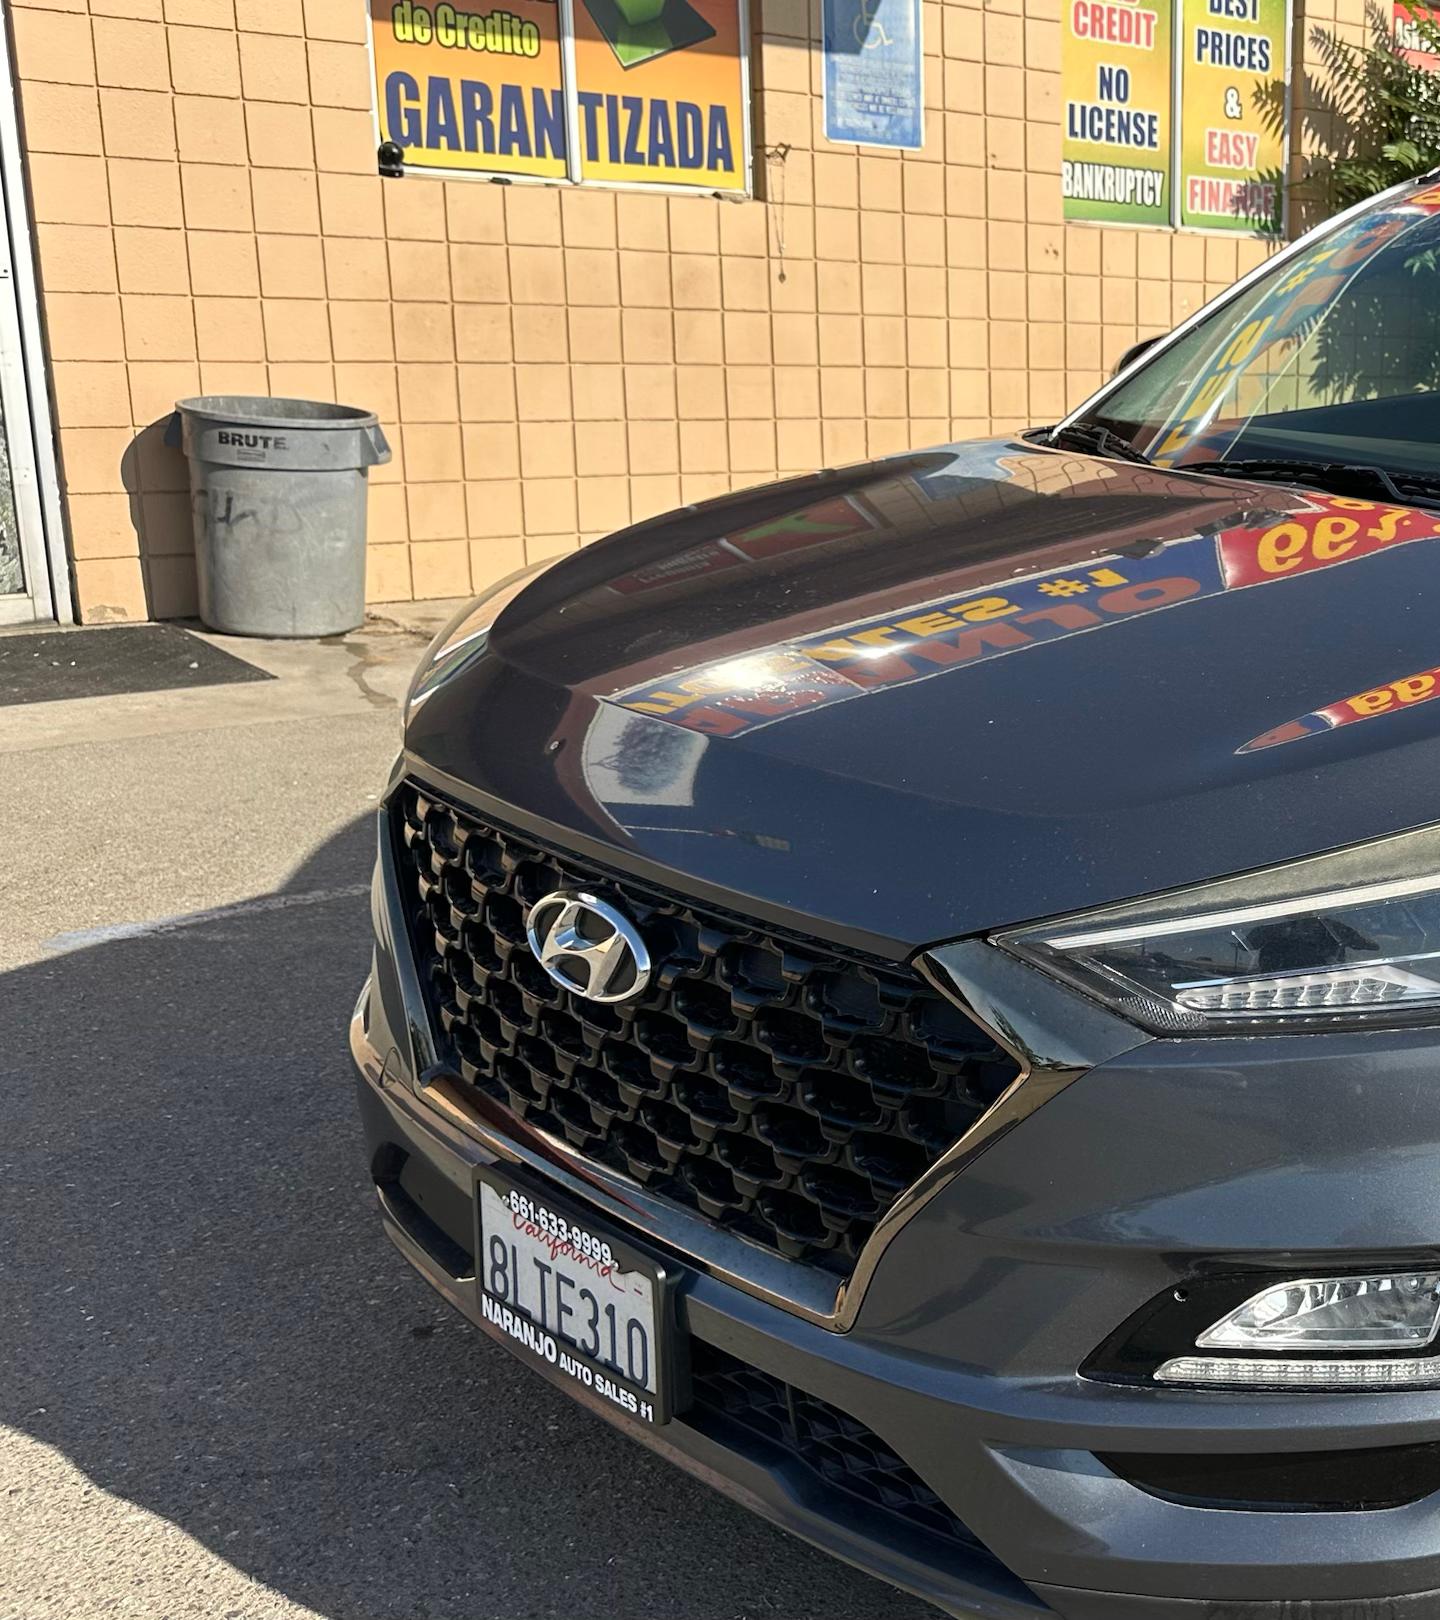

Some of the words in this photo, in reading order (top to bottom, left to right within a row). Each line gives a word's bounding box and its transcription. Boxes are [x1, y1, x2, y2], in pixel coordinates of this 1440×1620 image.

[393, 0, 432, 45] de
[435, 3, 540, 58] Credito
[1073, 1, 1155, 48] CREDIT
[1196, 28, 1270, 72] PRICES
[1099, 66, 1129, 103] NO
[1224, 86, 1242, 120] &
[385, 71, 735, 173] GARANTIZADA
[1068, 103, 1158, 148] LICENSE
[1207, 131, 1257, 169] EASY
[1063, 160, 1164, 207] BANKRUPTCY
[1188, 178, 1276, 216] FINANCE
[218, 431, 286, 450] BRUTE
[509, 1190, 612, 1265] 661-633-9999
[490, 1234, 649, 1390] 8LTE310
[482, 1294, 557, 1363] NARANJO
[559, 1352, 592, 1386] AUTO
[595, 1374, 637, 1413] SALES
[640, 1401, 653, 1422] #1
